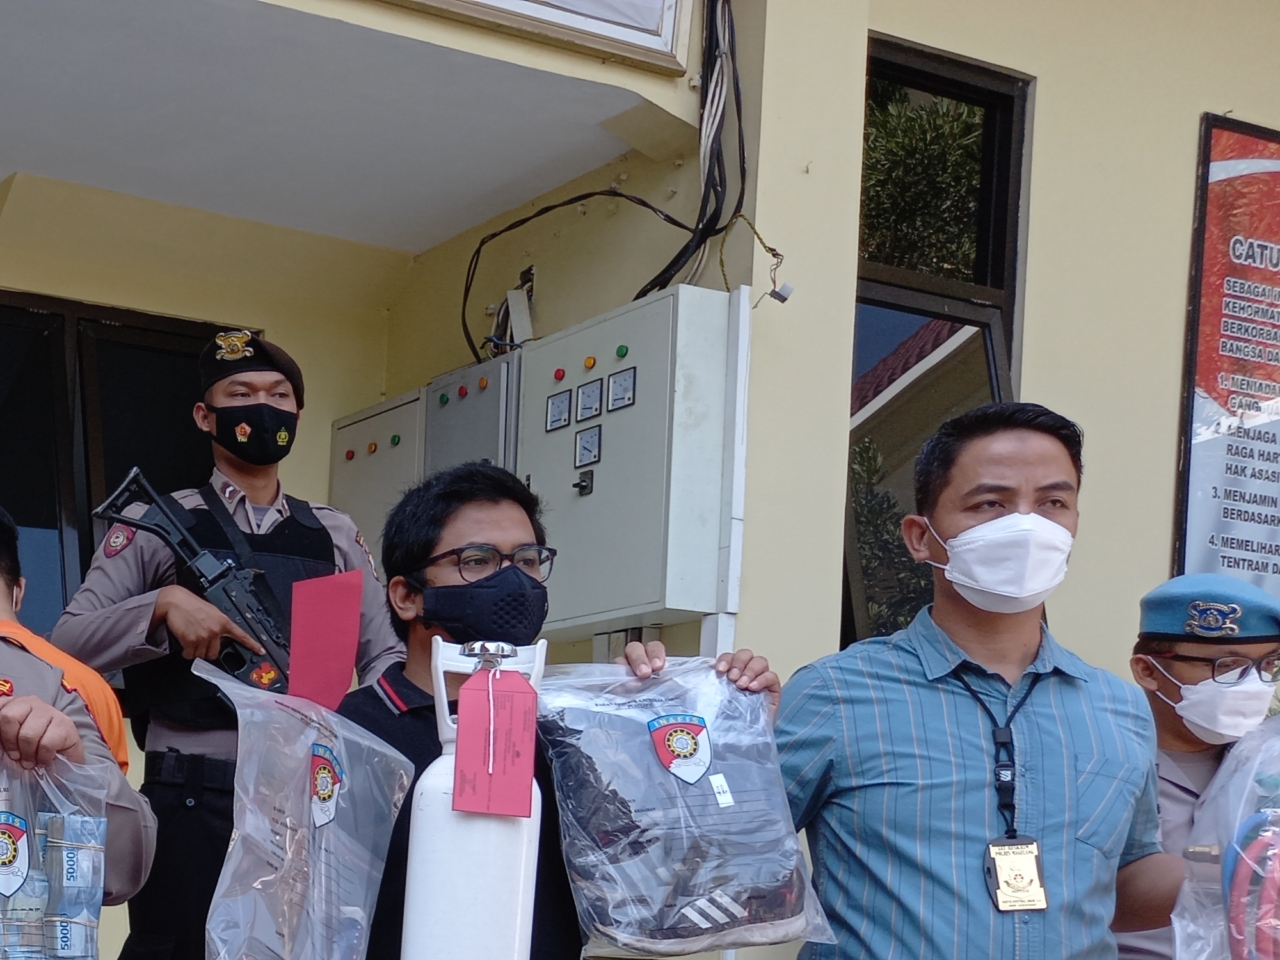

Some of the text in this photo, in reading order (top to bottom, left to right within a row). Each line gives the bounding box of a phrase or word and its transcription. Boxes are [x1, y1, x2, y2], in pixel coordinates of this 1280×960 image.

[1229, 236, 1280, 271] CATU
[1224, 277, 1272, 300] SEBAGAI
[1220, 318, 1280, 346] BERKORBA
[1219, 339, 1264, 362] BANGSA
[1230, 374, 1280, 398] MENIADA
[1226, 443, 1255, 460] RAGA
[1225, 462, 1248, 478] HAK
[1211, 486, 1278, 509] 3. MENJAMIN
[1208, 534, 1218, 547] 4.
[1220, 555, 1269, 573] TENTRAM
[654, 715, 699, 726] INAFIS
